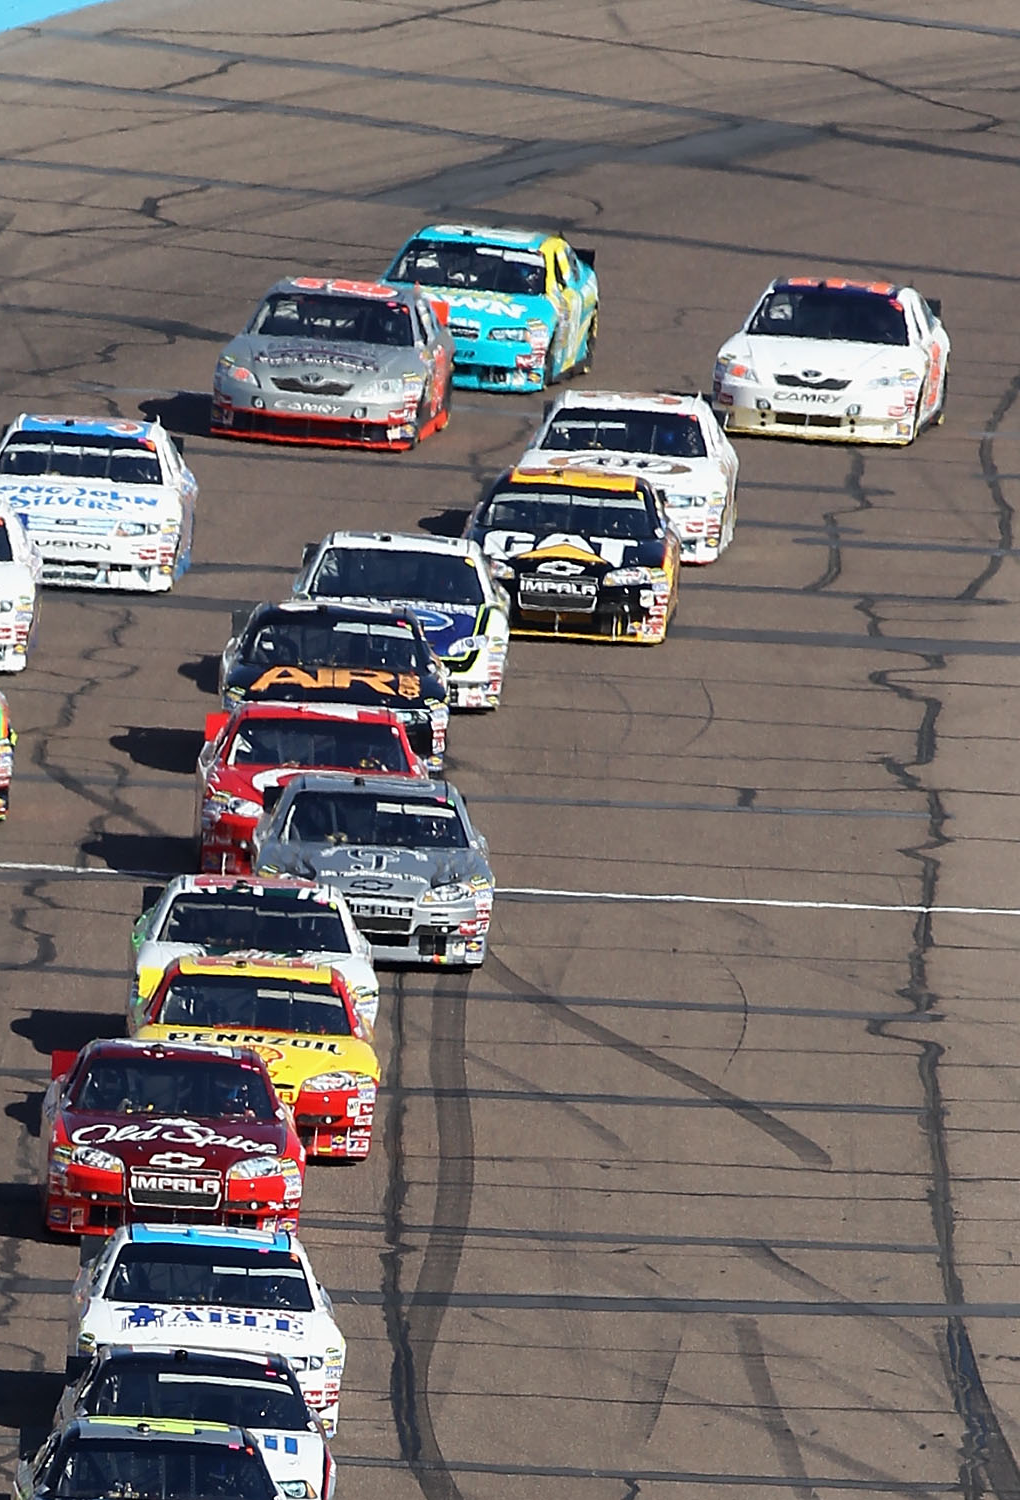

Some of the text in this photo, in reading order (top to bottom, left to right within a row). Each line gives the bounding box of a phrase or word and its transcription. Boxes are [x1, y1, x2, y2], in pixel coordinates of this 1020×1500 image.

[772, 391, 841, 404] CAMRY
[34, 539, 112, 551] USION
[483, 530, 639, 568] CAT
[520, 579, 597, 596] IMPALA
[350, 903, 413, 917] PALA
[167, 1030, 347, 1056] PENNZOIL
[71, 1123, 279, 1155] Old Spice
[130, 1175, 220, 1193] IMPALA
[169, 1311, 305, 1336] ABLE
